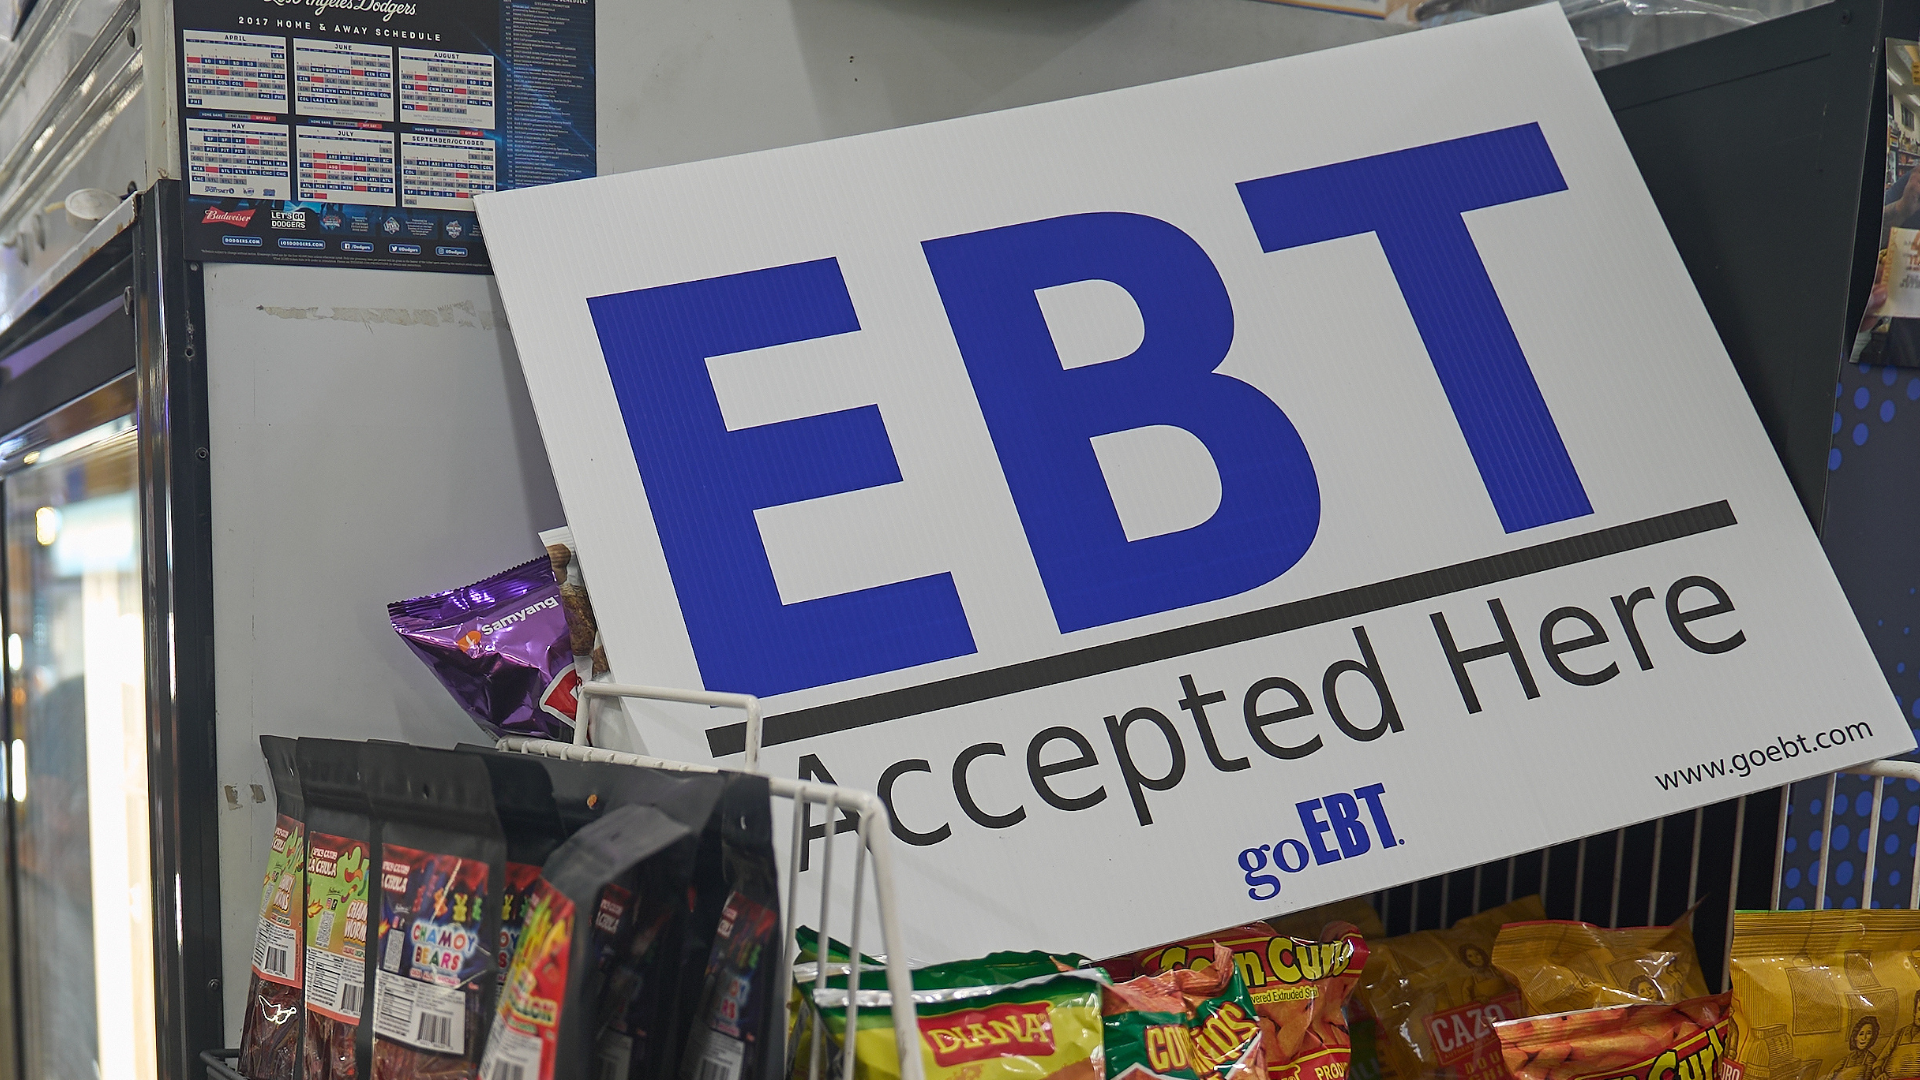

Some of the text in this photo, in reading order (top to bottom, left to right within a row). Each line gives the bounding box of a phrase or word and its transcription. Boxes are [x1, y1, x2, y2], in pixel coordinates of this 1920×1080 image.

[353, 0, 416, 22] Dodgers
[224, 34, 247, 42] APRIL
[238, 16, 441, 42] 2017 HOME & AWAY SCHEDULE
[412, 136, 484, 146] SEPTEMBER/OCTOBER
[205, 210, 251, 222] Budweiser
[271, 212, 303, 220] LET'S GO
[271, 221, 306, 229] DODGERS
[586, 121, 1593, 707] EBT
[481, 596, 560, 635] Samyang
[798, 575, 1747, 873] Accepted Here
[1655, 721, 1874, 791] www.goebt.com
[317, 860, 337, 877] CHULA
[413, 924, 476, 952] CHAMOY
[415, 945, 460, 971] BEARS
[1272, 988, 1304, 1002] Extruded
[927, 1013, 1049, 1054] DIANA
